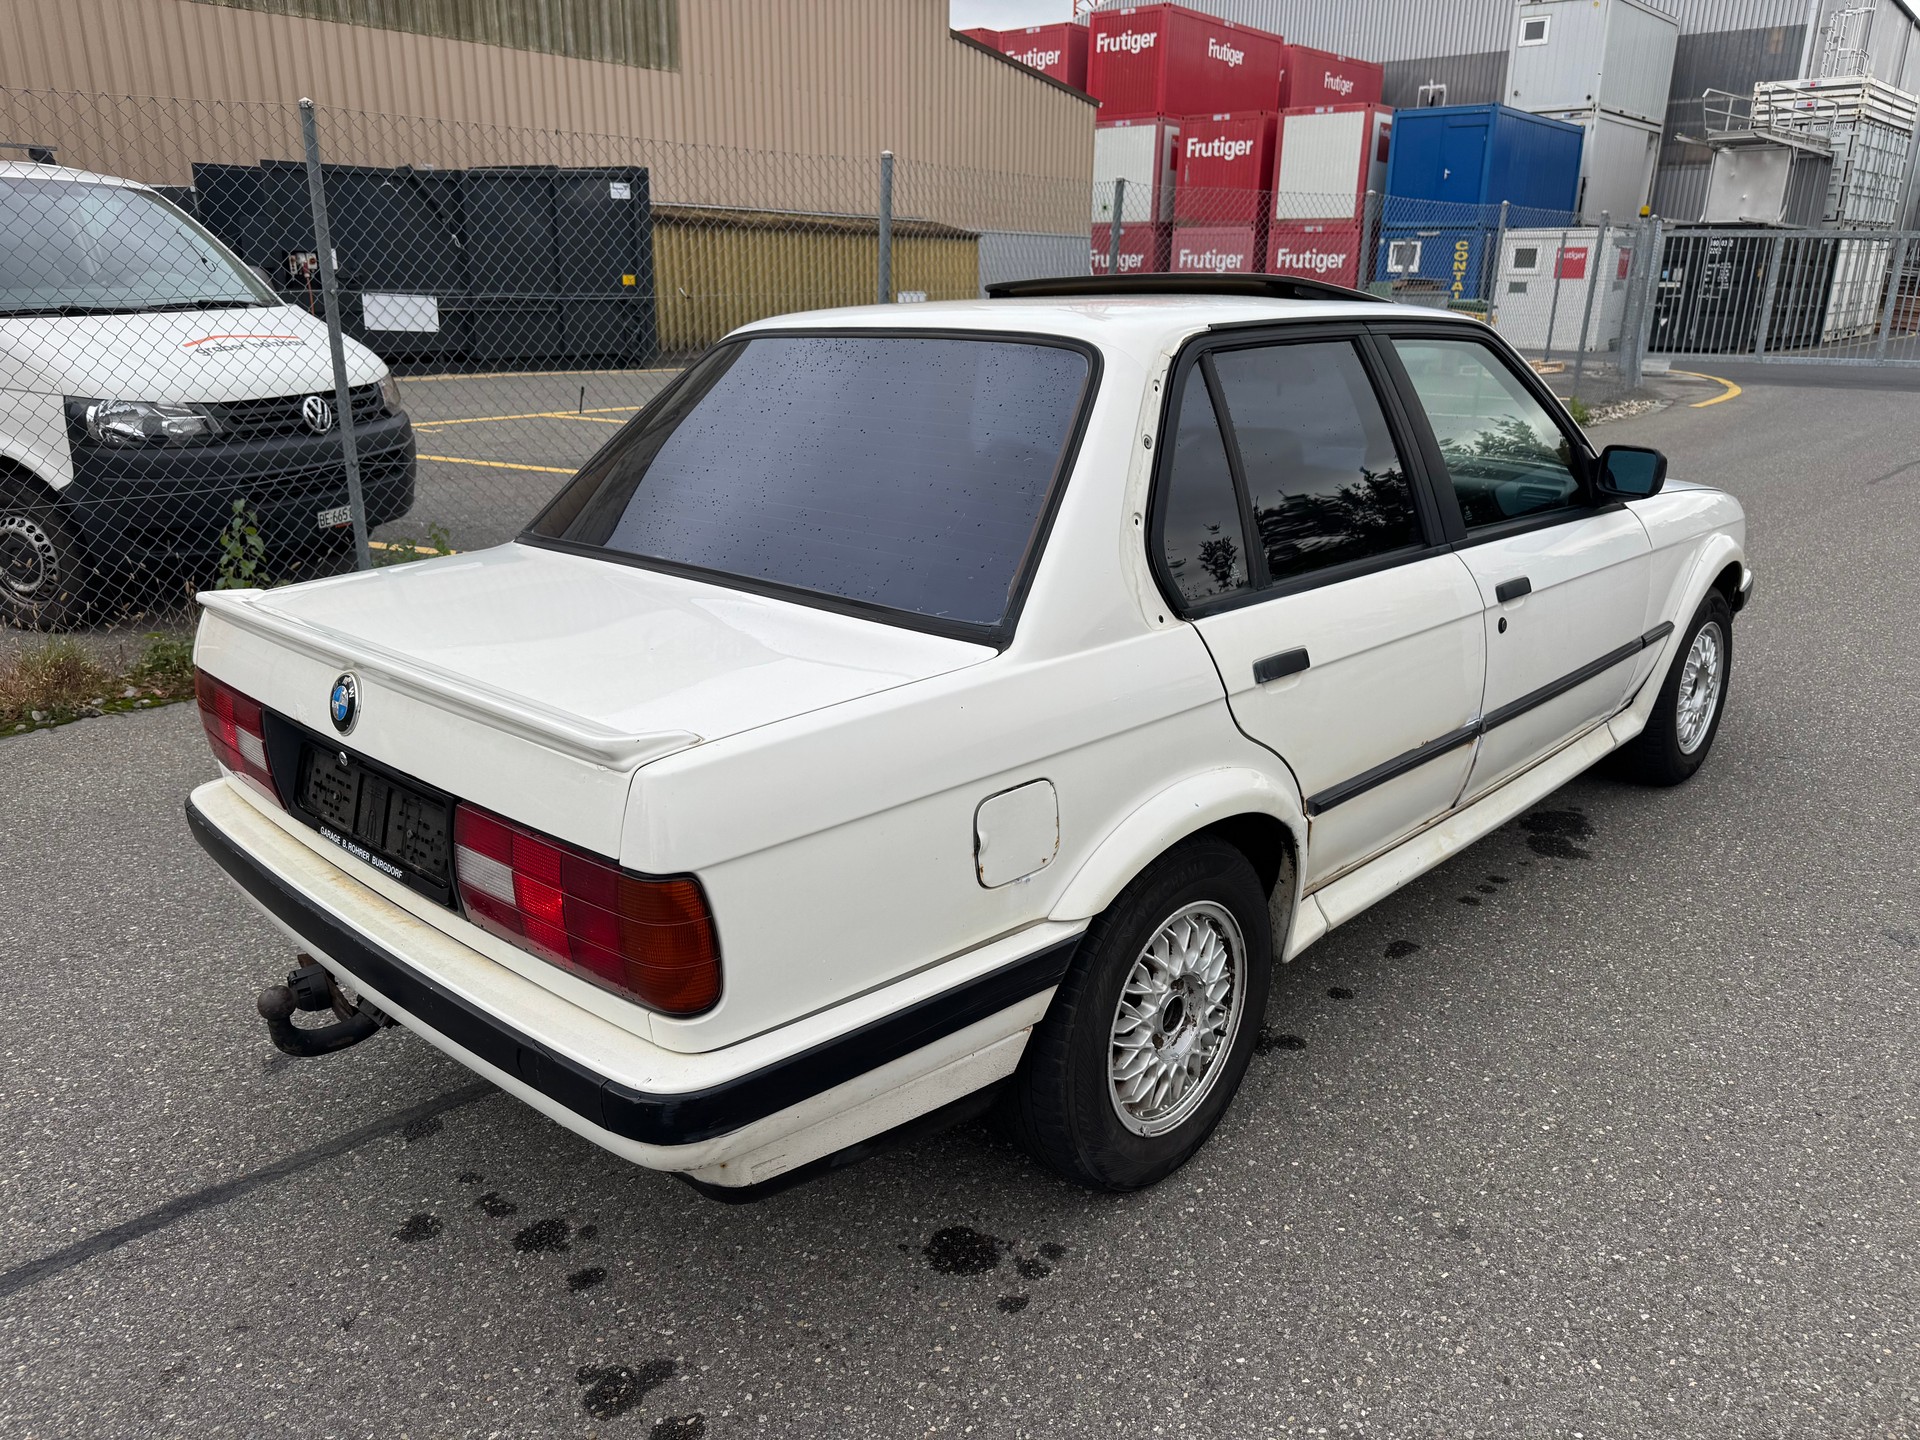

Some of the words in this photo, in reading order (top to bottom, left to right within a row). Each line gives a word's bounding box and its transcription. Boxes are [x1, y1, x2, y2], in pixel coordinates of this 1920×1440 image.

[1096, 30, 1157, 54] Frutiger
[1208, 38, 1244, 67] Frutiger
[1324, 71, 1354, 96] Frutiger
[1187, 136, 1253, 160] Frutiger
[1090, 249, 1145, 272] Fruiger
[1178, 248, 1243, 272] Frutiger
[1276, 248, 1346, 273] Frutiger
[1558, 251, 1586, 261] utiger
[320, 826, 341, 845] GARAGE
[371, 855, 403, 879] BURGDORF
